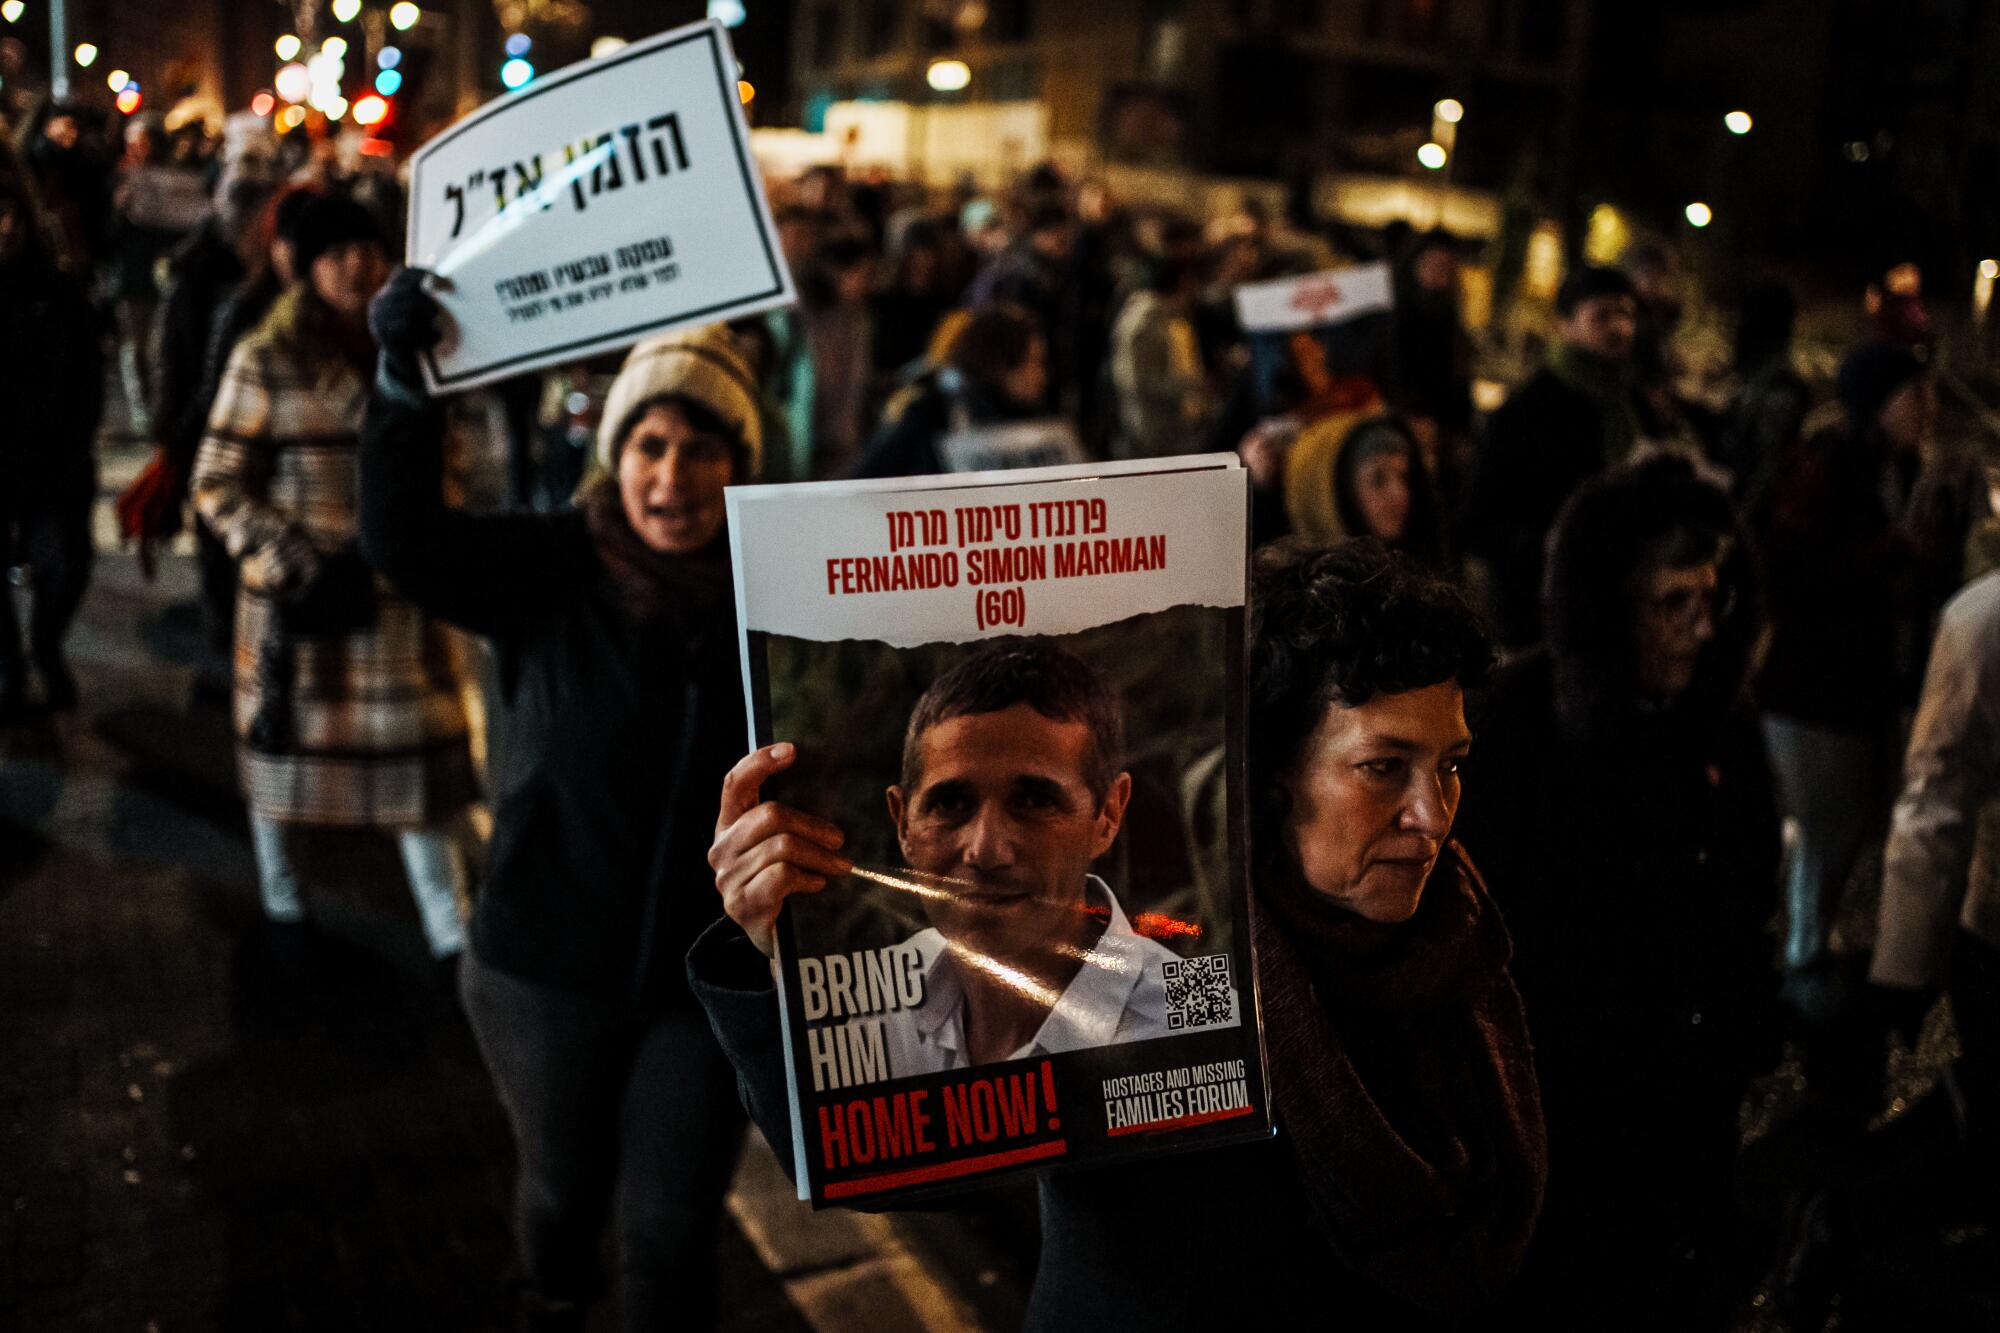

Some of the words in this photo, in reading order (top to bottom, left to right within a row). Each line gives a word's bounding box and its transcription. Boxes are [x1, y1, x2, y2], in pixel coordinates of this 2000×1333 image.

[886, 509, 948, 552] מרמן
[955, 503, 1021, 548] סימון
[1028, 498, 1106, 538] פרננדו
[826, 551, 959, 595] FERNANDO
[966, 545, 1046, 585] SIMON
[1054, 535, 1166, 579] MARMAN
[976, 586, 1025, 630] (60)
[798, 947, 923, 1022] BRING
[807, 1019, 888, 1092] HIM
[1102, 1071, 1164, 1099] HOSTAGES
[1166, 1067, 1191, 1089] AND
[1192, 1059, 1246, 1085] MISSING
[1105, 1089, 1184, 1130] FAMILIES
[1187, 1080, 1249, 1117] FORUM
[818, 1090, 936, 1169] HOME
